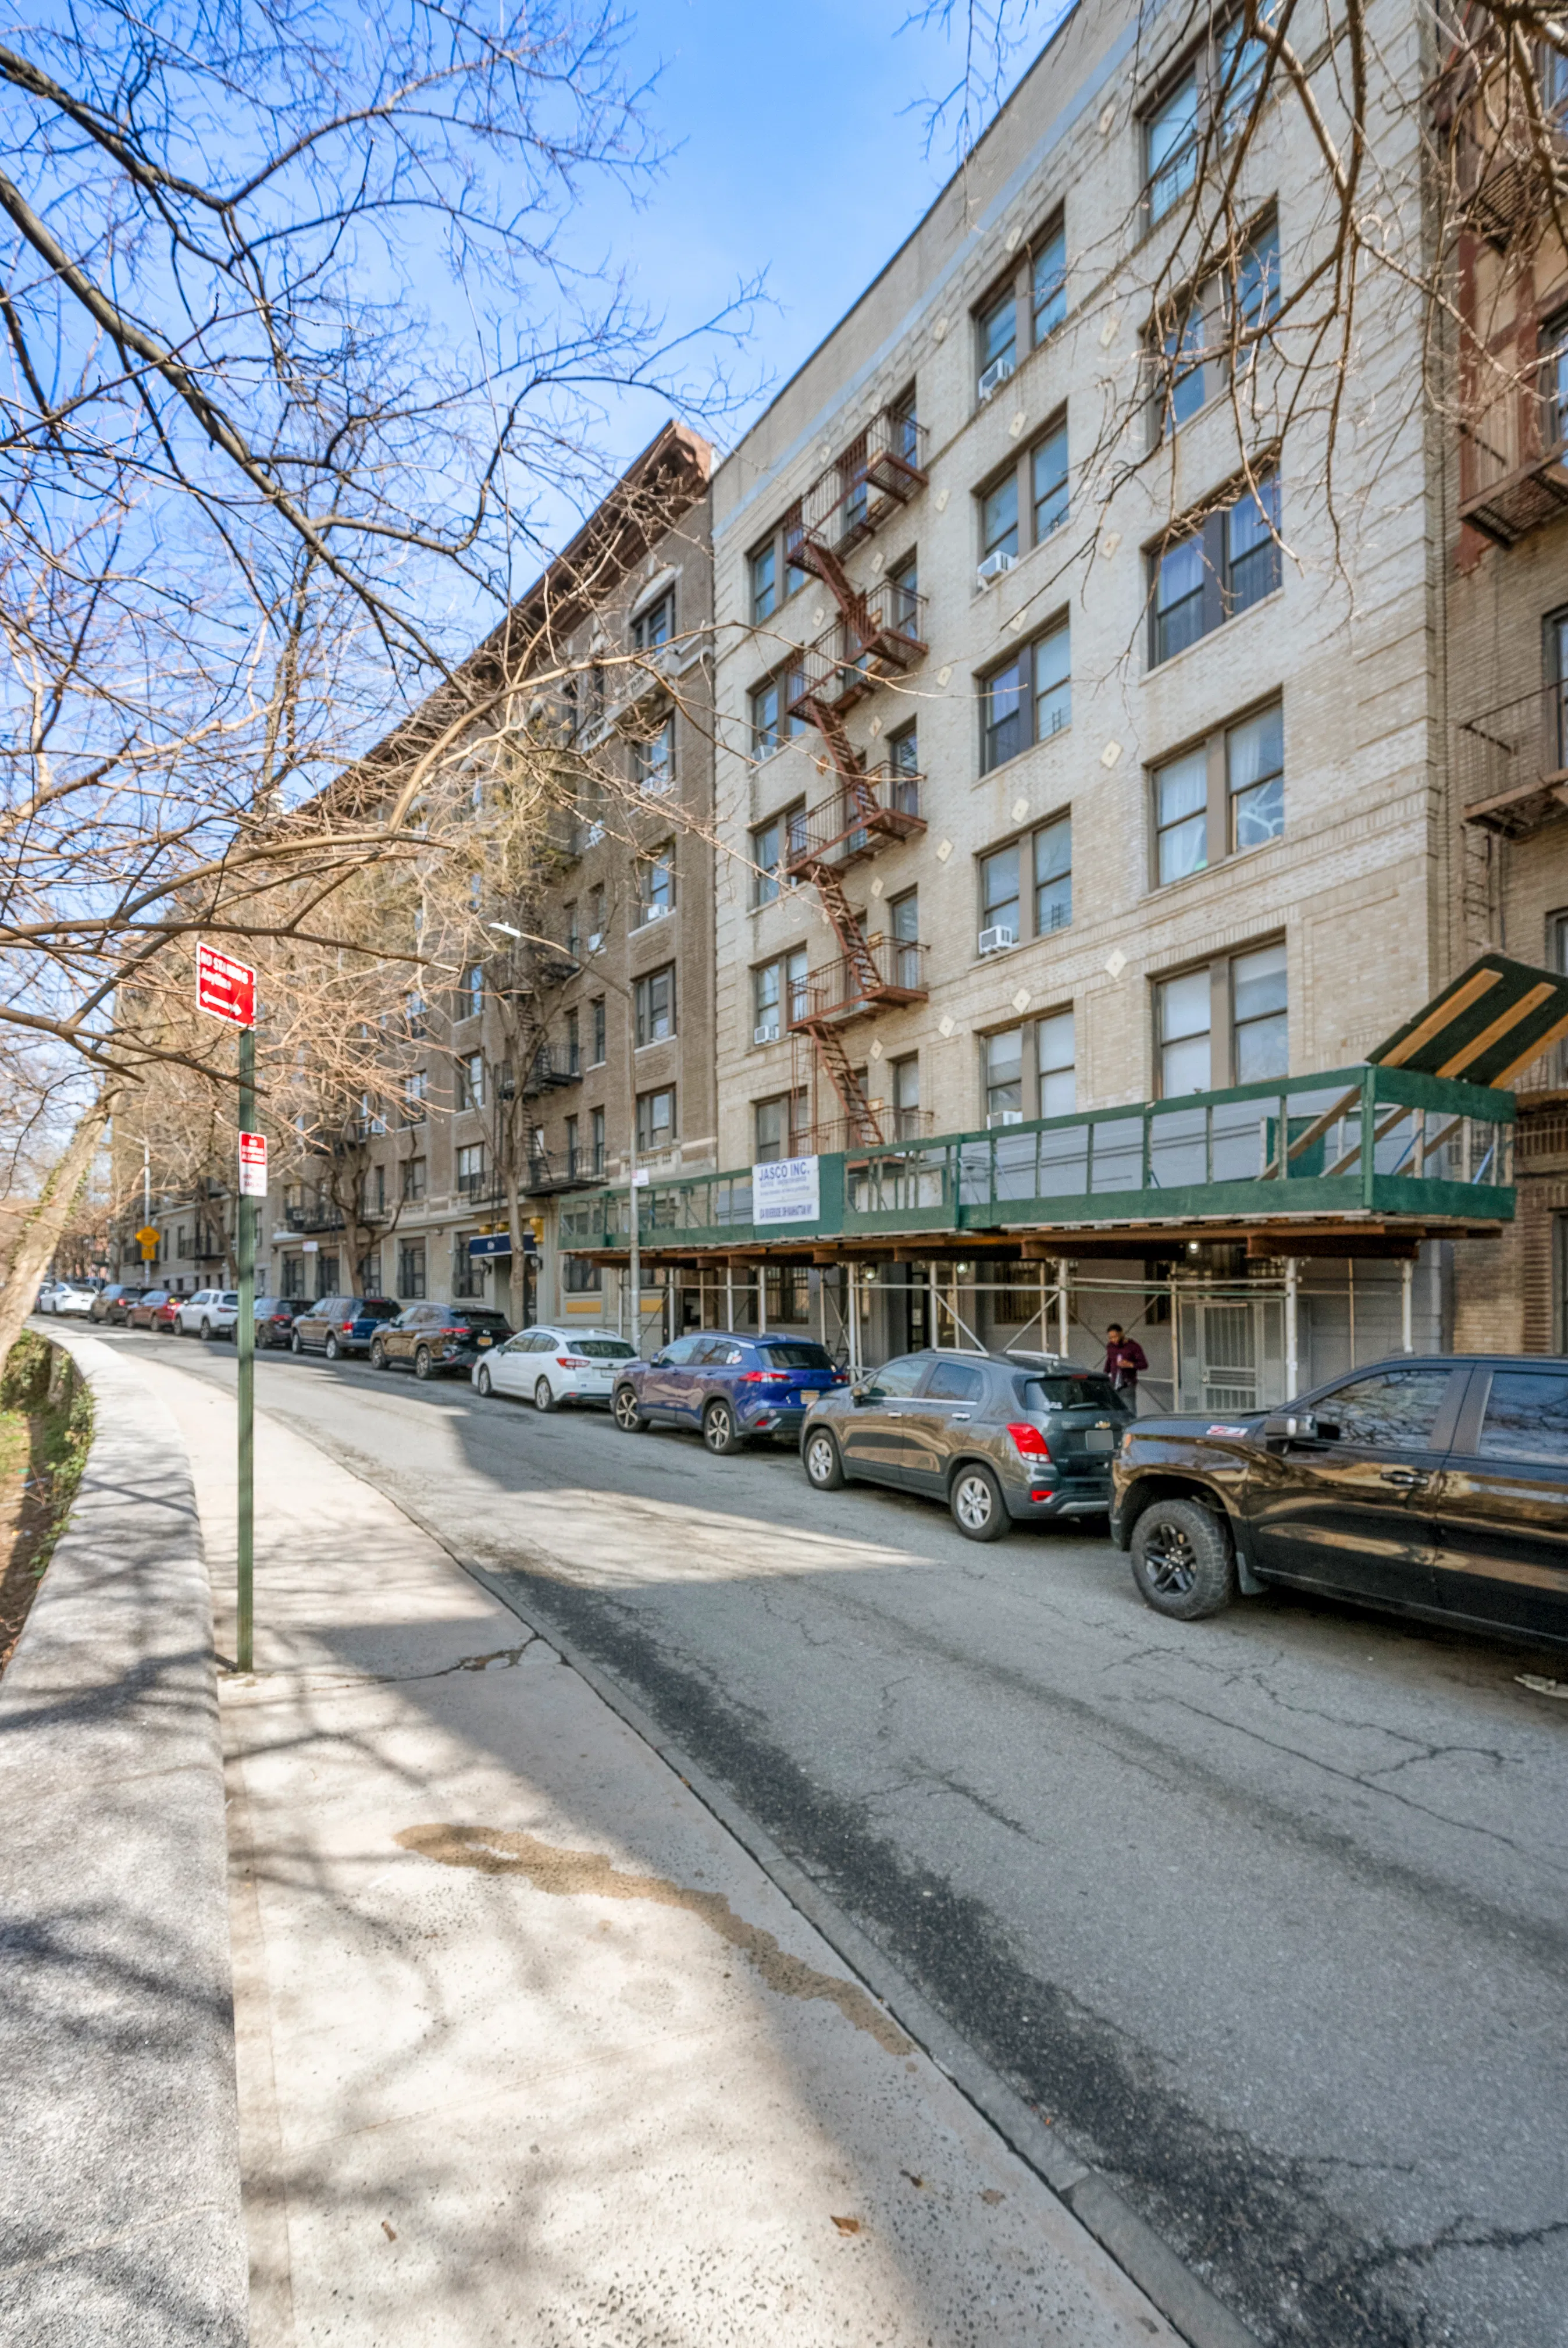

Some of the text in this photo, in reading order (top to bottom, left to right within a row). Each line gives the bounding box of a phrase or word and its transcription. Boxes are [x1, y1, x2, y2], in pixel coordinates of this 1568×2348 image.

[201, 951, 249, 984] NO STANDING
[201, 967, 231, 990] Anytime
[759, 1162, 810, 1181] JASCO INC.
